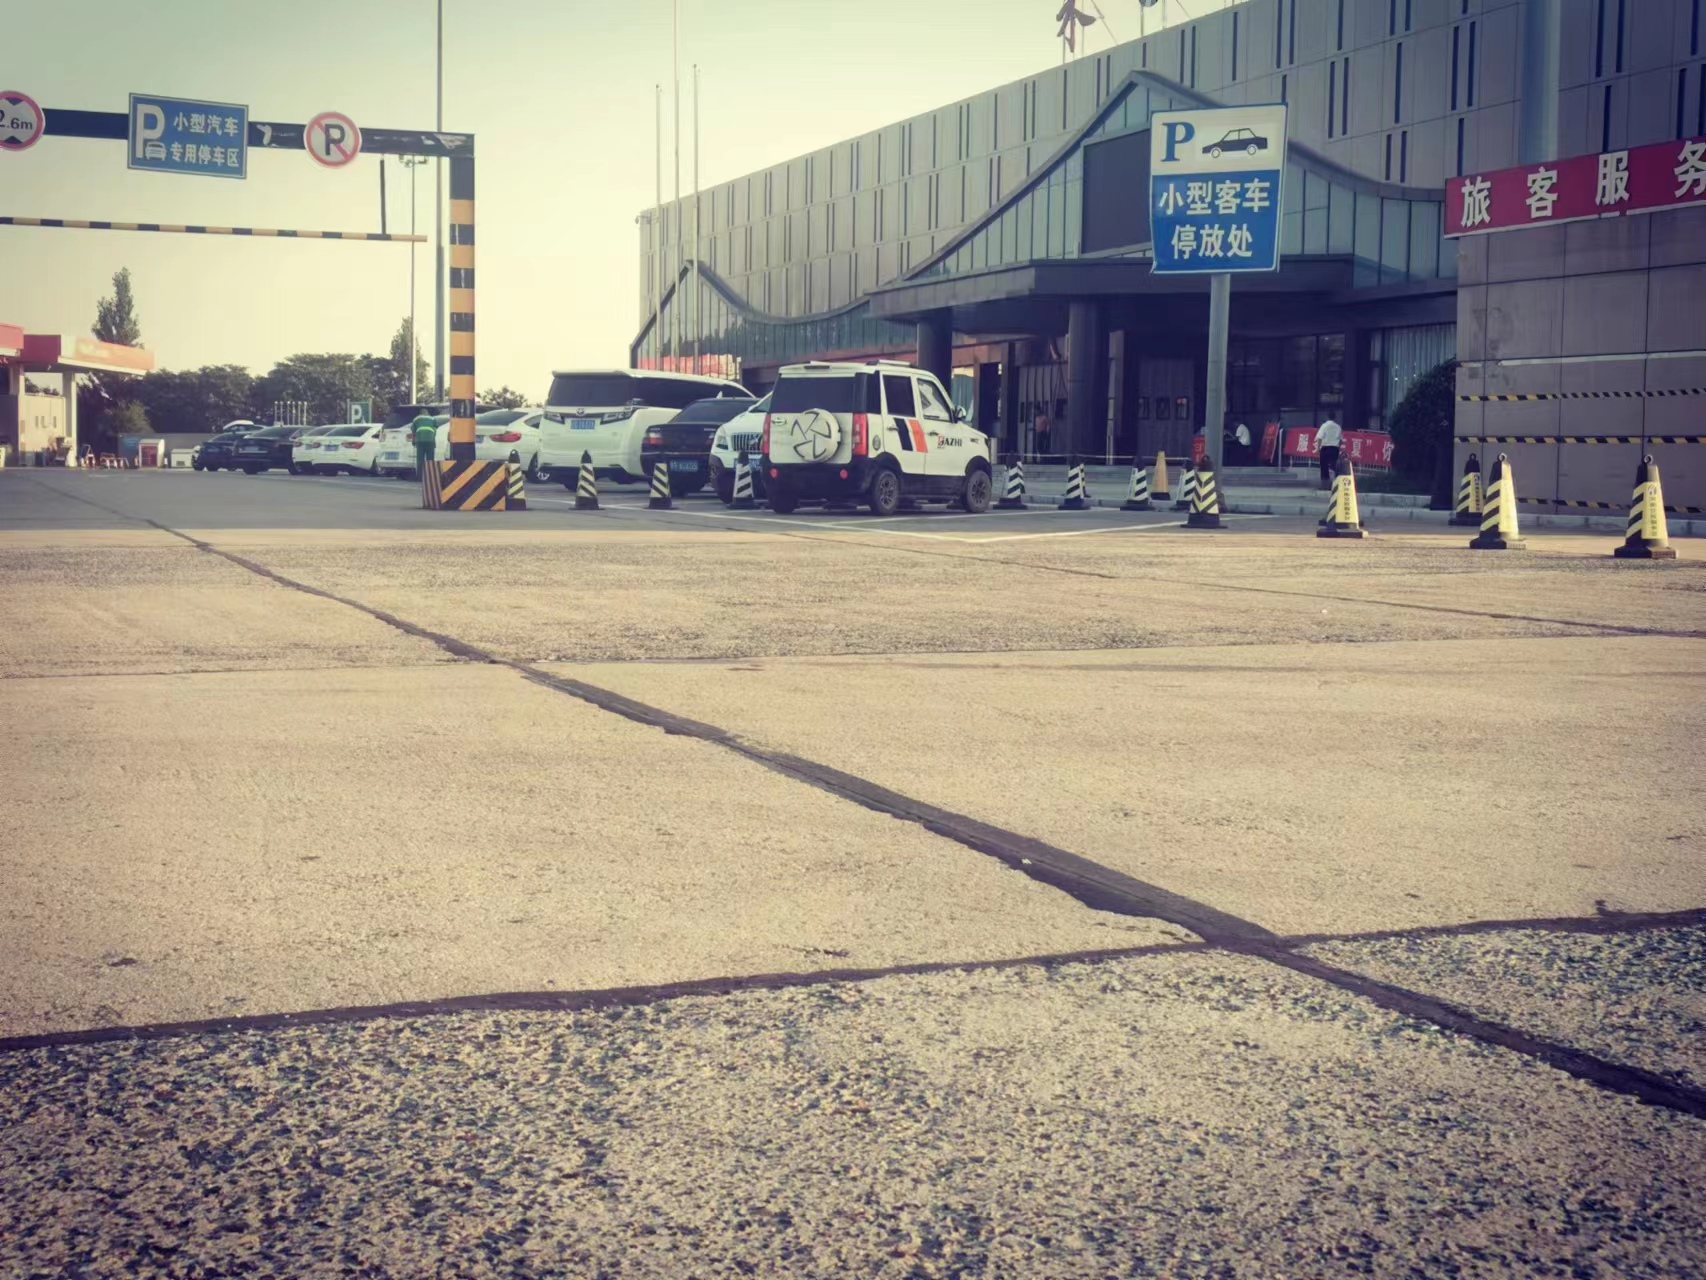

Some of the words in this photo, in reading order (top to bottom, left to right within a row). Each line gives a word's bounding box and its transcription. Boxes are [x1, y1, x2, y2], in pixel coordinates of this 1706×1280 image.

[136, 103, 166, 159] P
[173, 111, 239, 137] 小型汽车
[324, 123, 346, 156] P
[1160, 121, 1196, 163] P
[170, 141, 240, 168] 专用停车区
[1158, 177, 1271, 216] 小型客车
[1459, 140, 1706, 229] 旅客服务
[1171, 223, 1253, 260] 停放处
[351, 404, 363, 425] P
